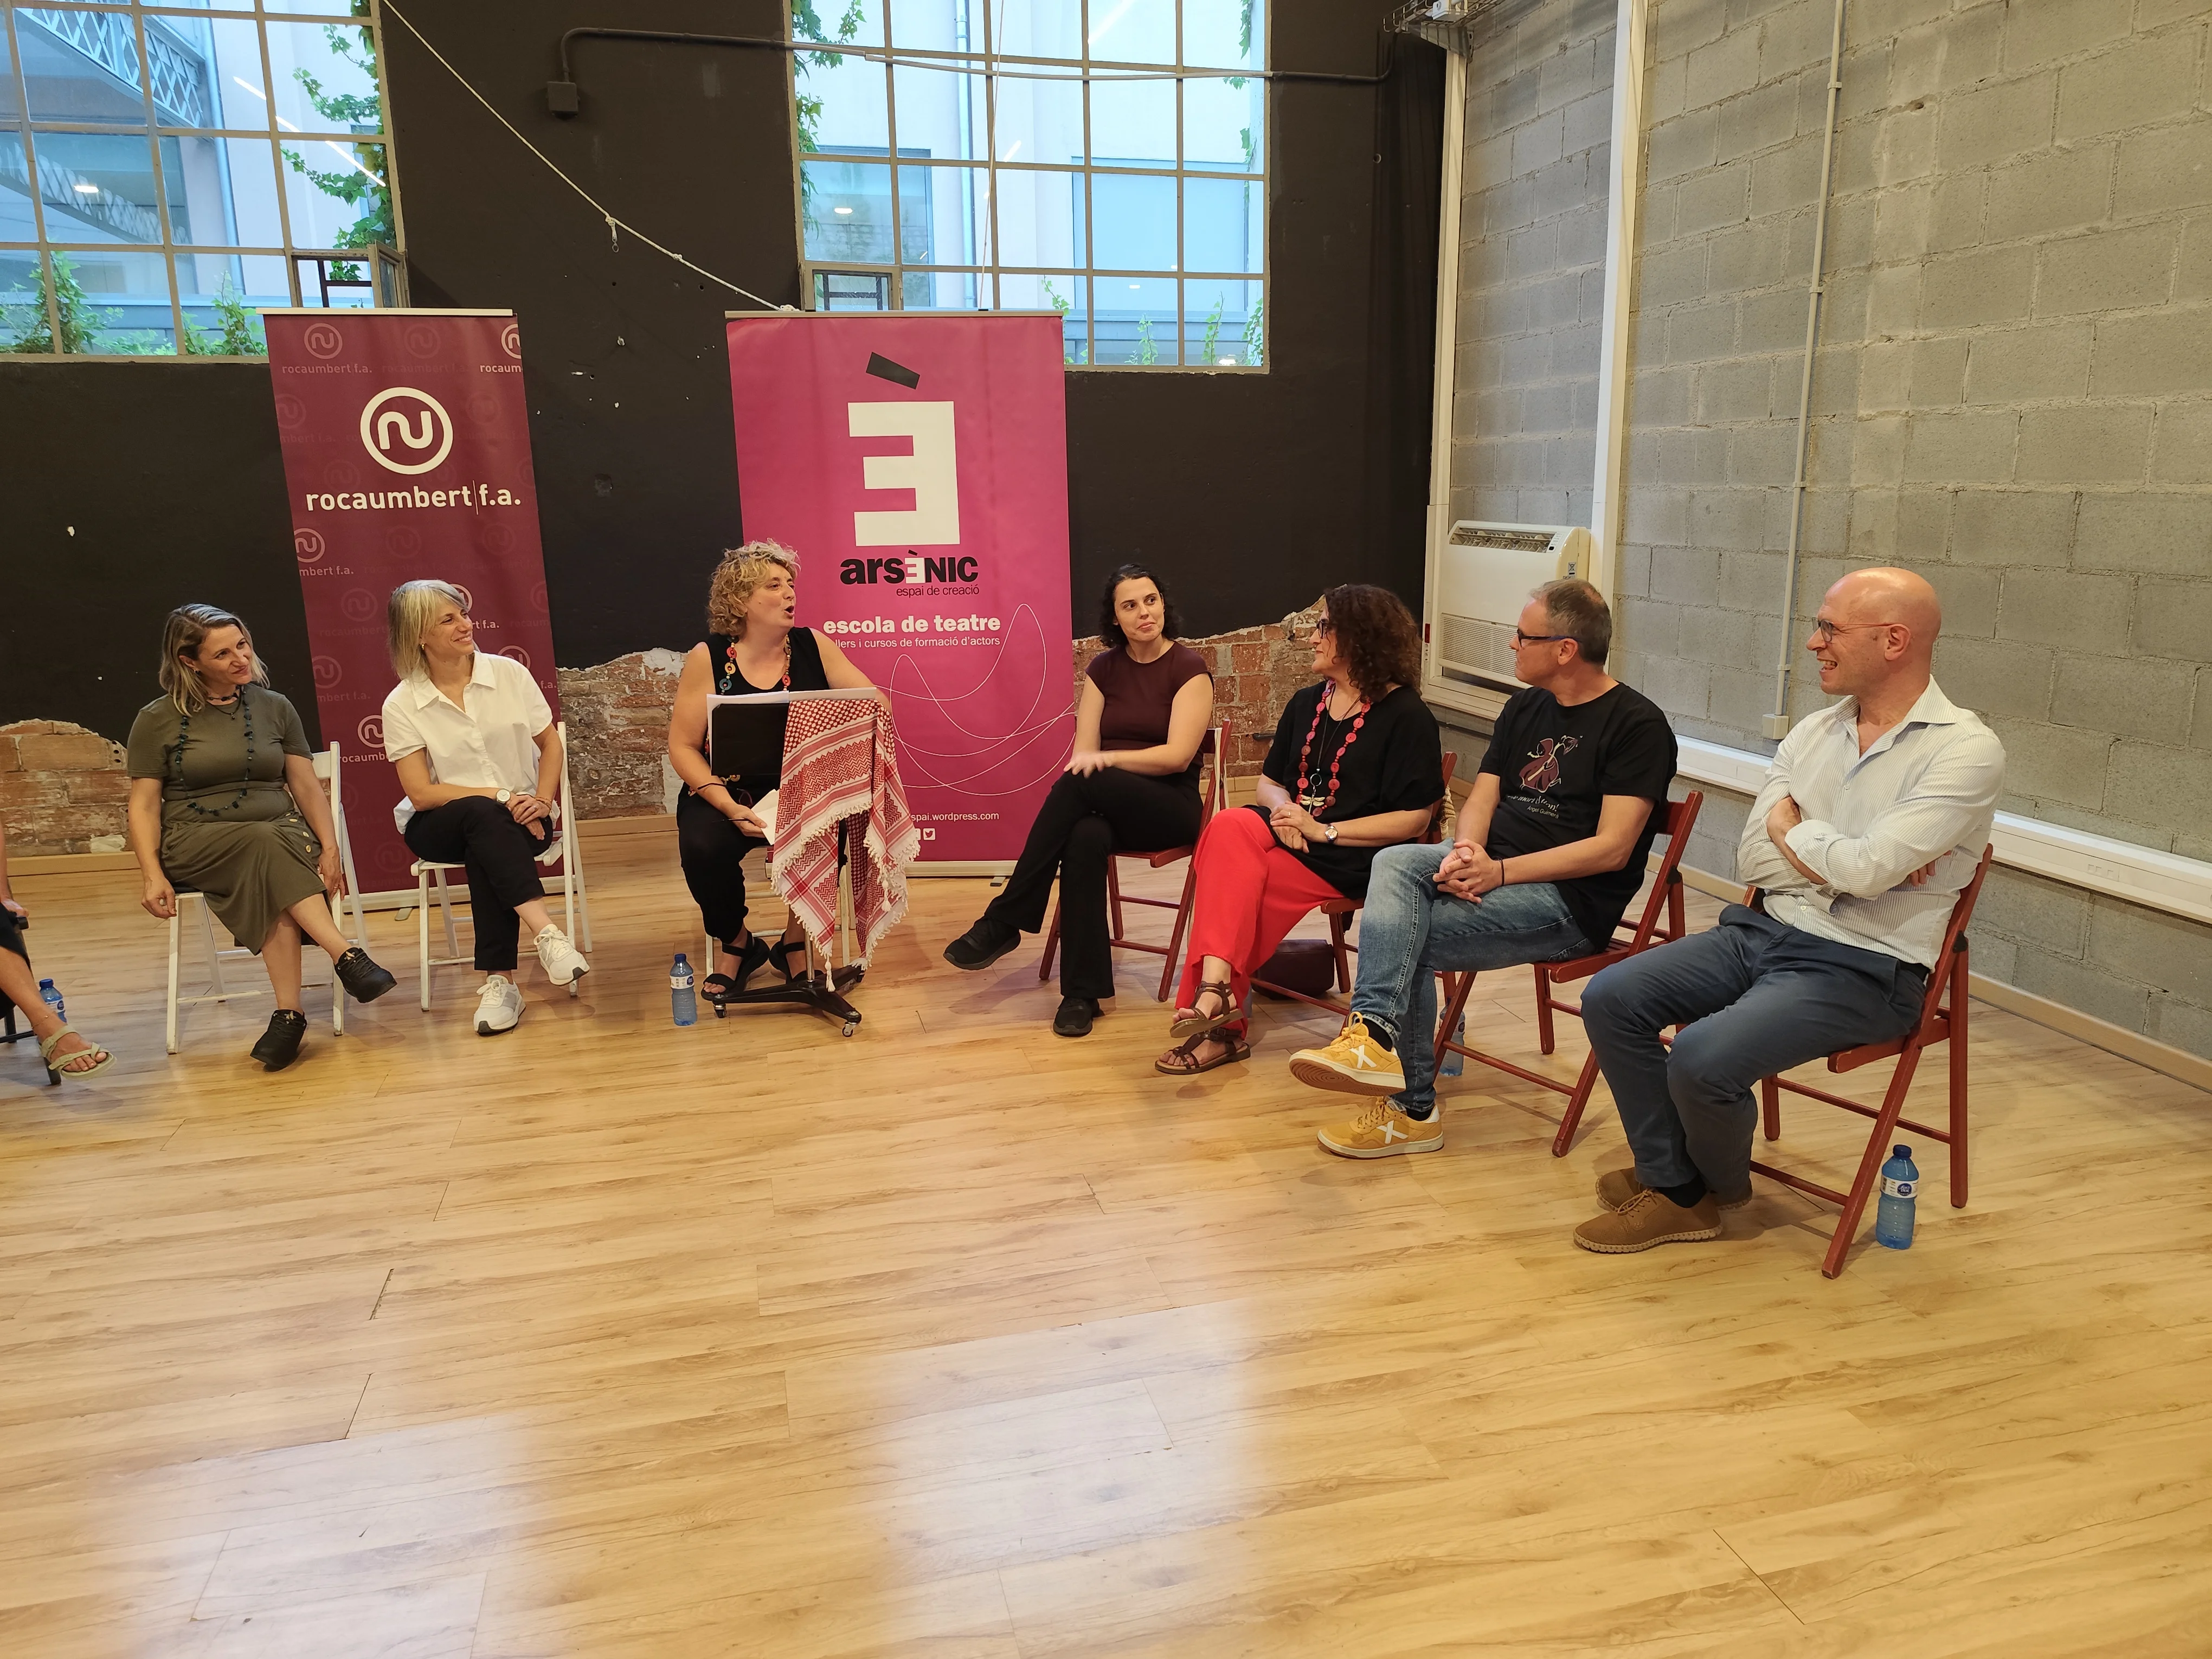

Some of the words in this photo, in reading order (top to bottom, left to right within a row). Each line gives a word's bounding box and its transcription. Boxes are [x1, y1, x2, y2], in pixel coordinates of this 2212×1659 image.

[282, 364, 351, 374] rocaumbert
[354, 363, 372, 373] f.a.
[480, 364, 523, 372] rocaum
[306, 485, 472, 511] rocaumbert
[479, 484, 521, 506] f.a.
[336, 565, 353, 575] f.a.
[896, 586, 924, 598] espai
[927, 586, 940, 596] de
[942, 584, 980, 595] creació
[483, 619, 500, 629] f.a.
[823, 616, 896, 634] escola
[901, 615, 929, 633] de
[934, 614, 1001, 632] teatre
[859, 639, 862, 648] i
[865, 639, 897, 648] cursos
[900, 637, 913, 647] de
[915, 636, 959, 647] formació
[961, 636, 1001, 646] d'actors
[540, 680, 557, 689] f.a.
[340, 751, 389, 763] ocaumb
[911, 812, 1000, 823] spai.wordpress.com
